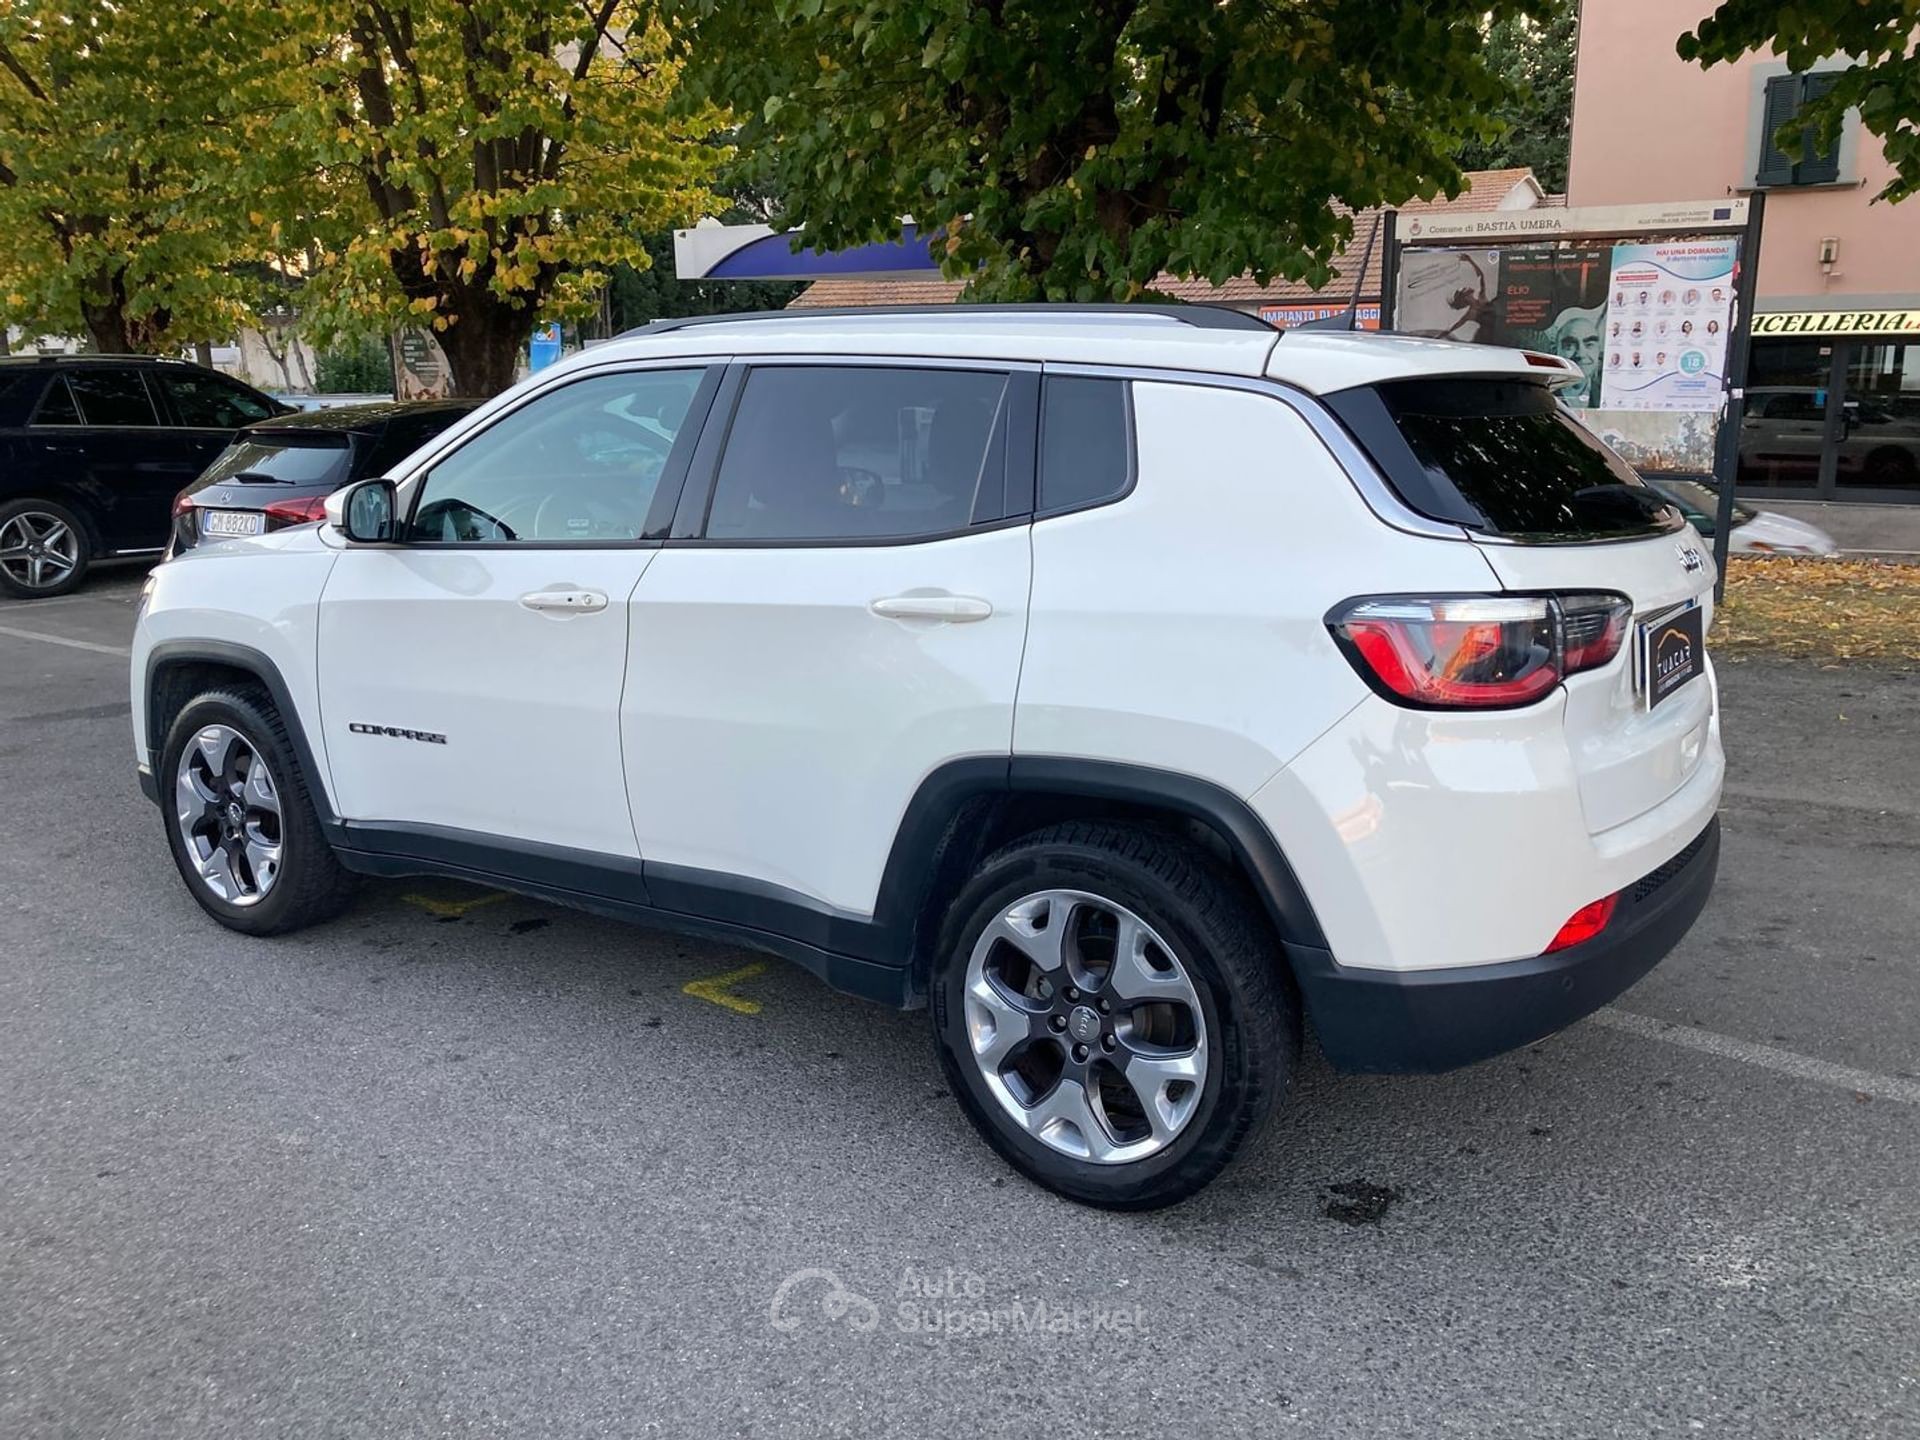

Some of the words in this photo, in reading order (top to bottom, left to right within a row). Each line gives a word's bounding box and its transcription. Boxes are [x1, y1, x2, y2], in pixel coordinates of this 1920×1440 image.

[1429, 225, 1463, 234] Comune
[1465, 223, 1474, 232] di
[1476, 221, 1517, 232] BASTIA
[1520, 219, 1562, 230] UMBRA
[1262, 310, 1316, 321] IMPIANTO
[1319, 309, 1331, 320] DI
[1334, 308, 1380, 320] LAGGI
[349, 722, 448, 745] COMPASS
